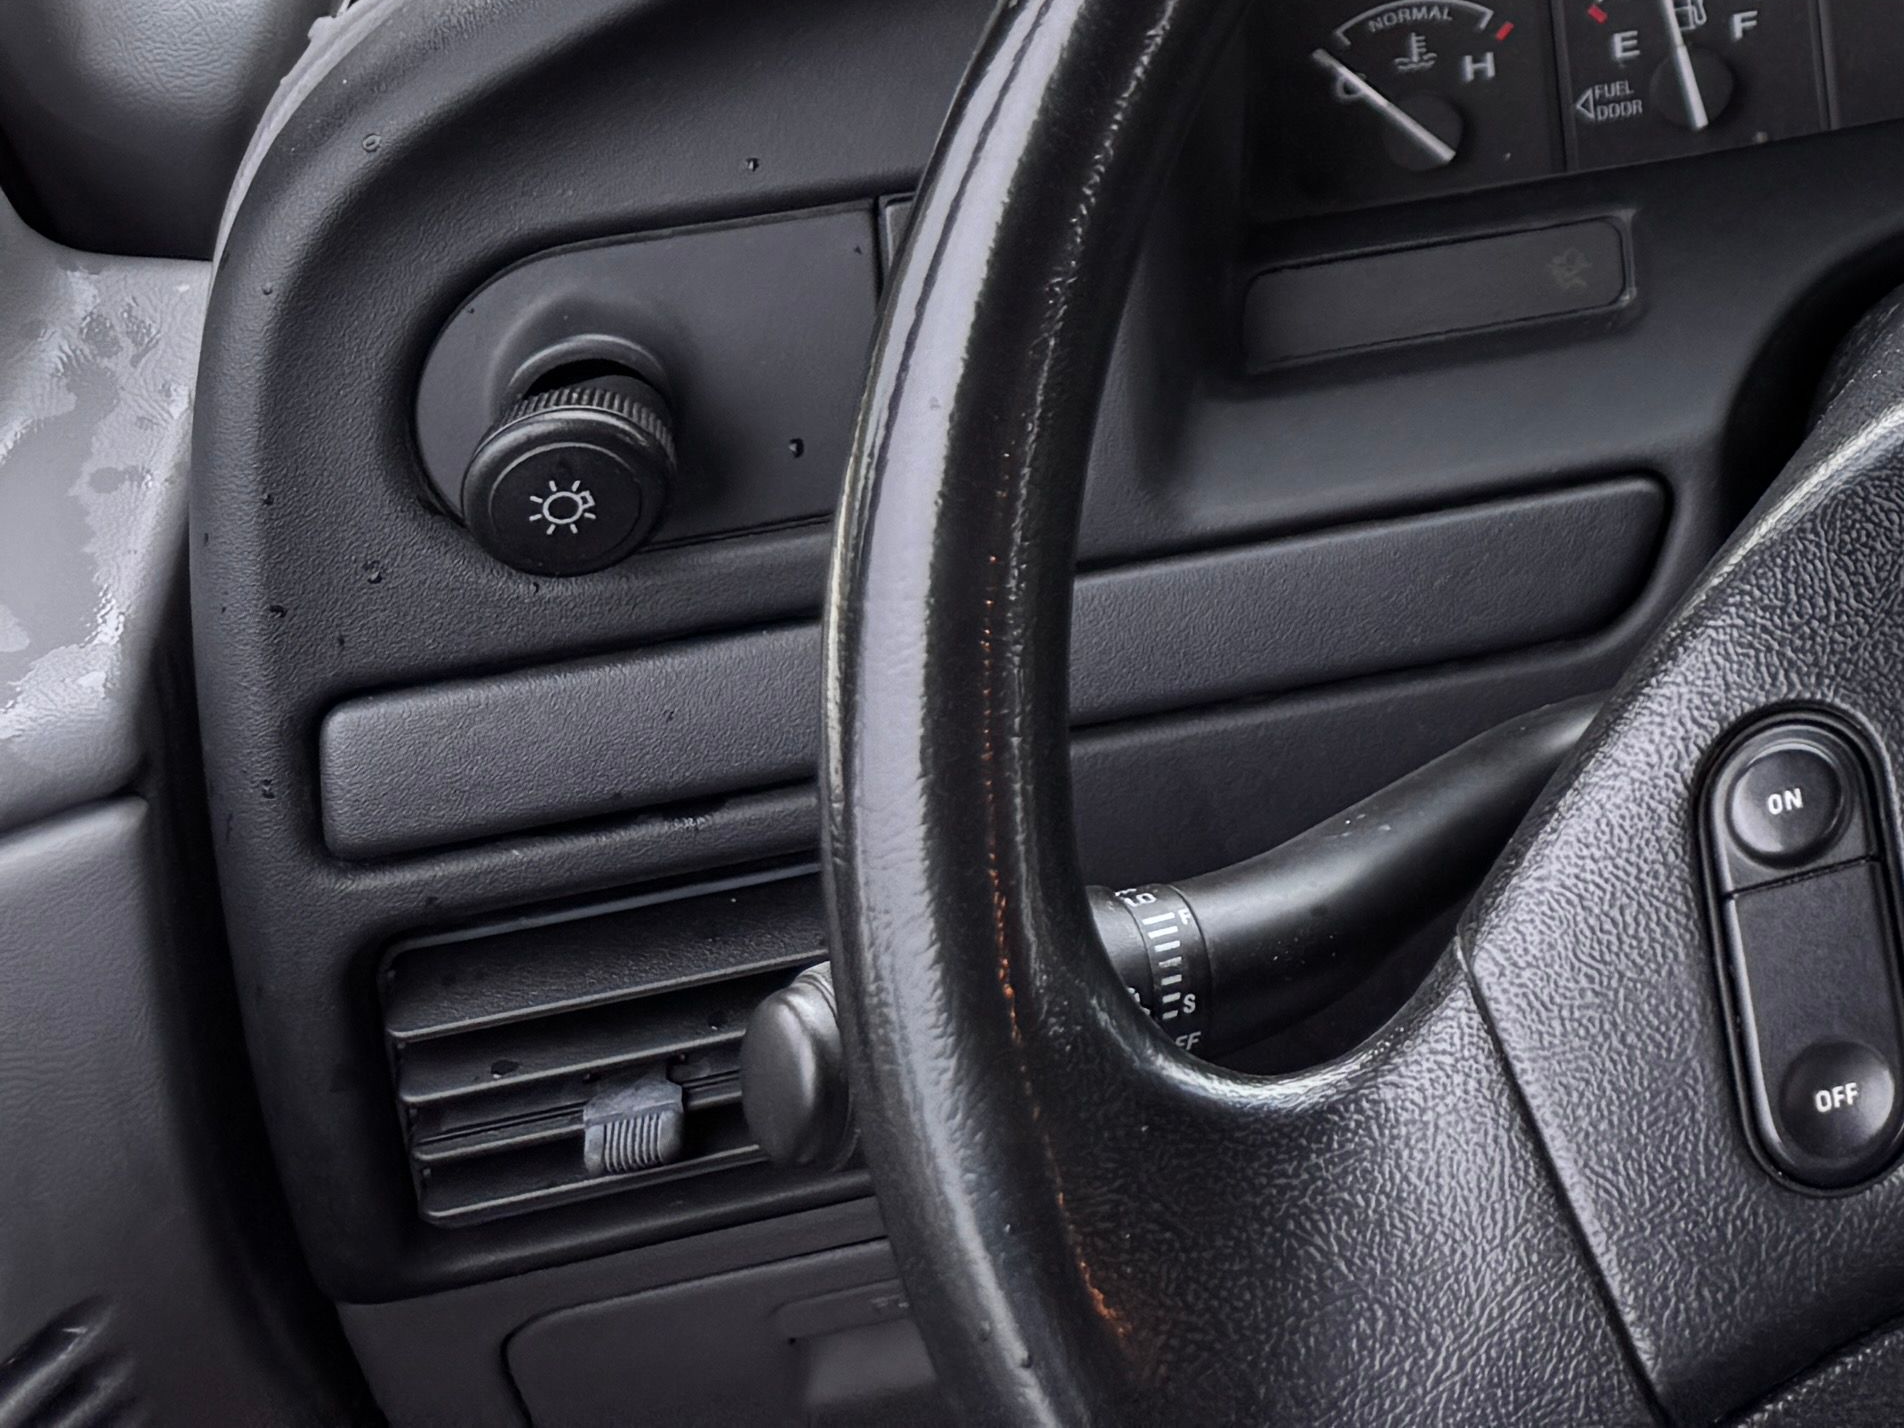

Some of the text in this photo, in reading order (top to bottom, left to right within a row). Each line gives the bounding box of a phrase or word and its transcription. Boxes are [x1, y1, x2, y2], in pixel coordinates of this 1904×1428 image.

[1368, 5, 1453, 32] NORMAL
[1732, 10, 1758, 41] F
[1613, 30, 1641, 59] E
[1461, 51, 1496, 83] H
[1594, 80, 1635, 99] FUEL
[1596, 99, 1643, 121] DOOR
[1767, 787, 1803, 815] ON
[1183, 994, 1196, 1014] S
[1814, 1081, 1859, 1114] OFF
